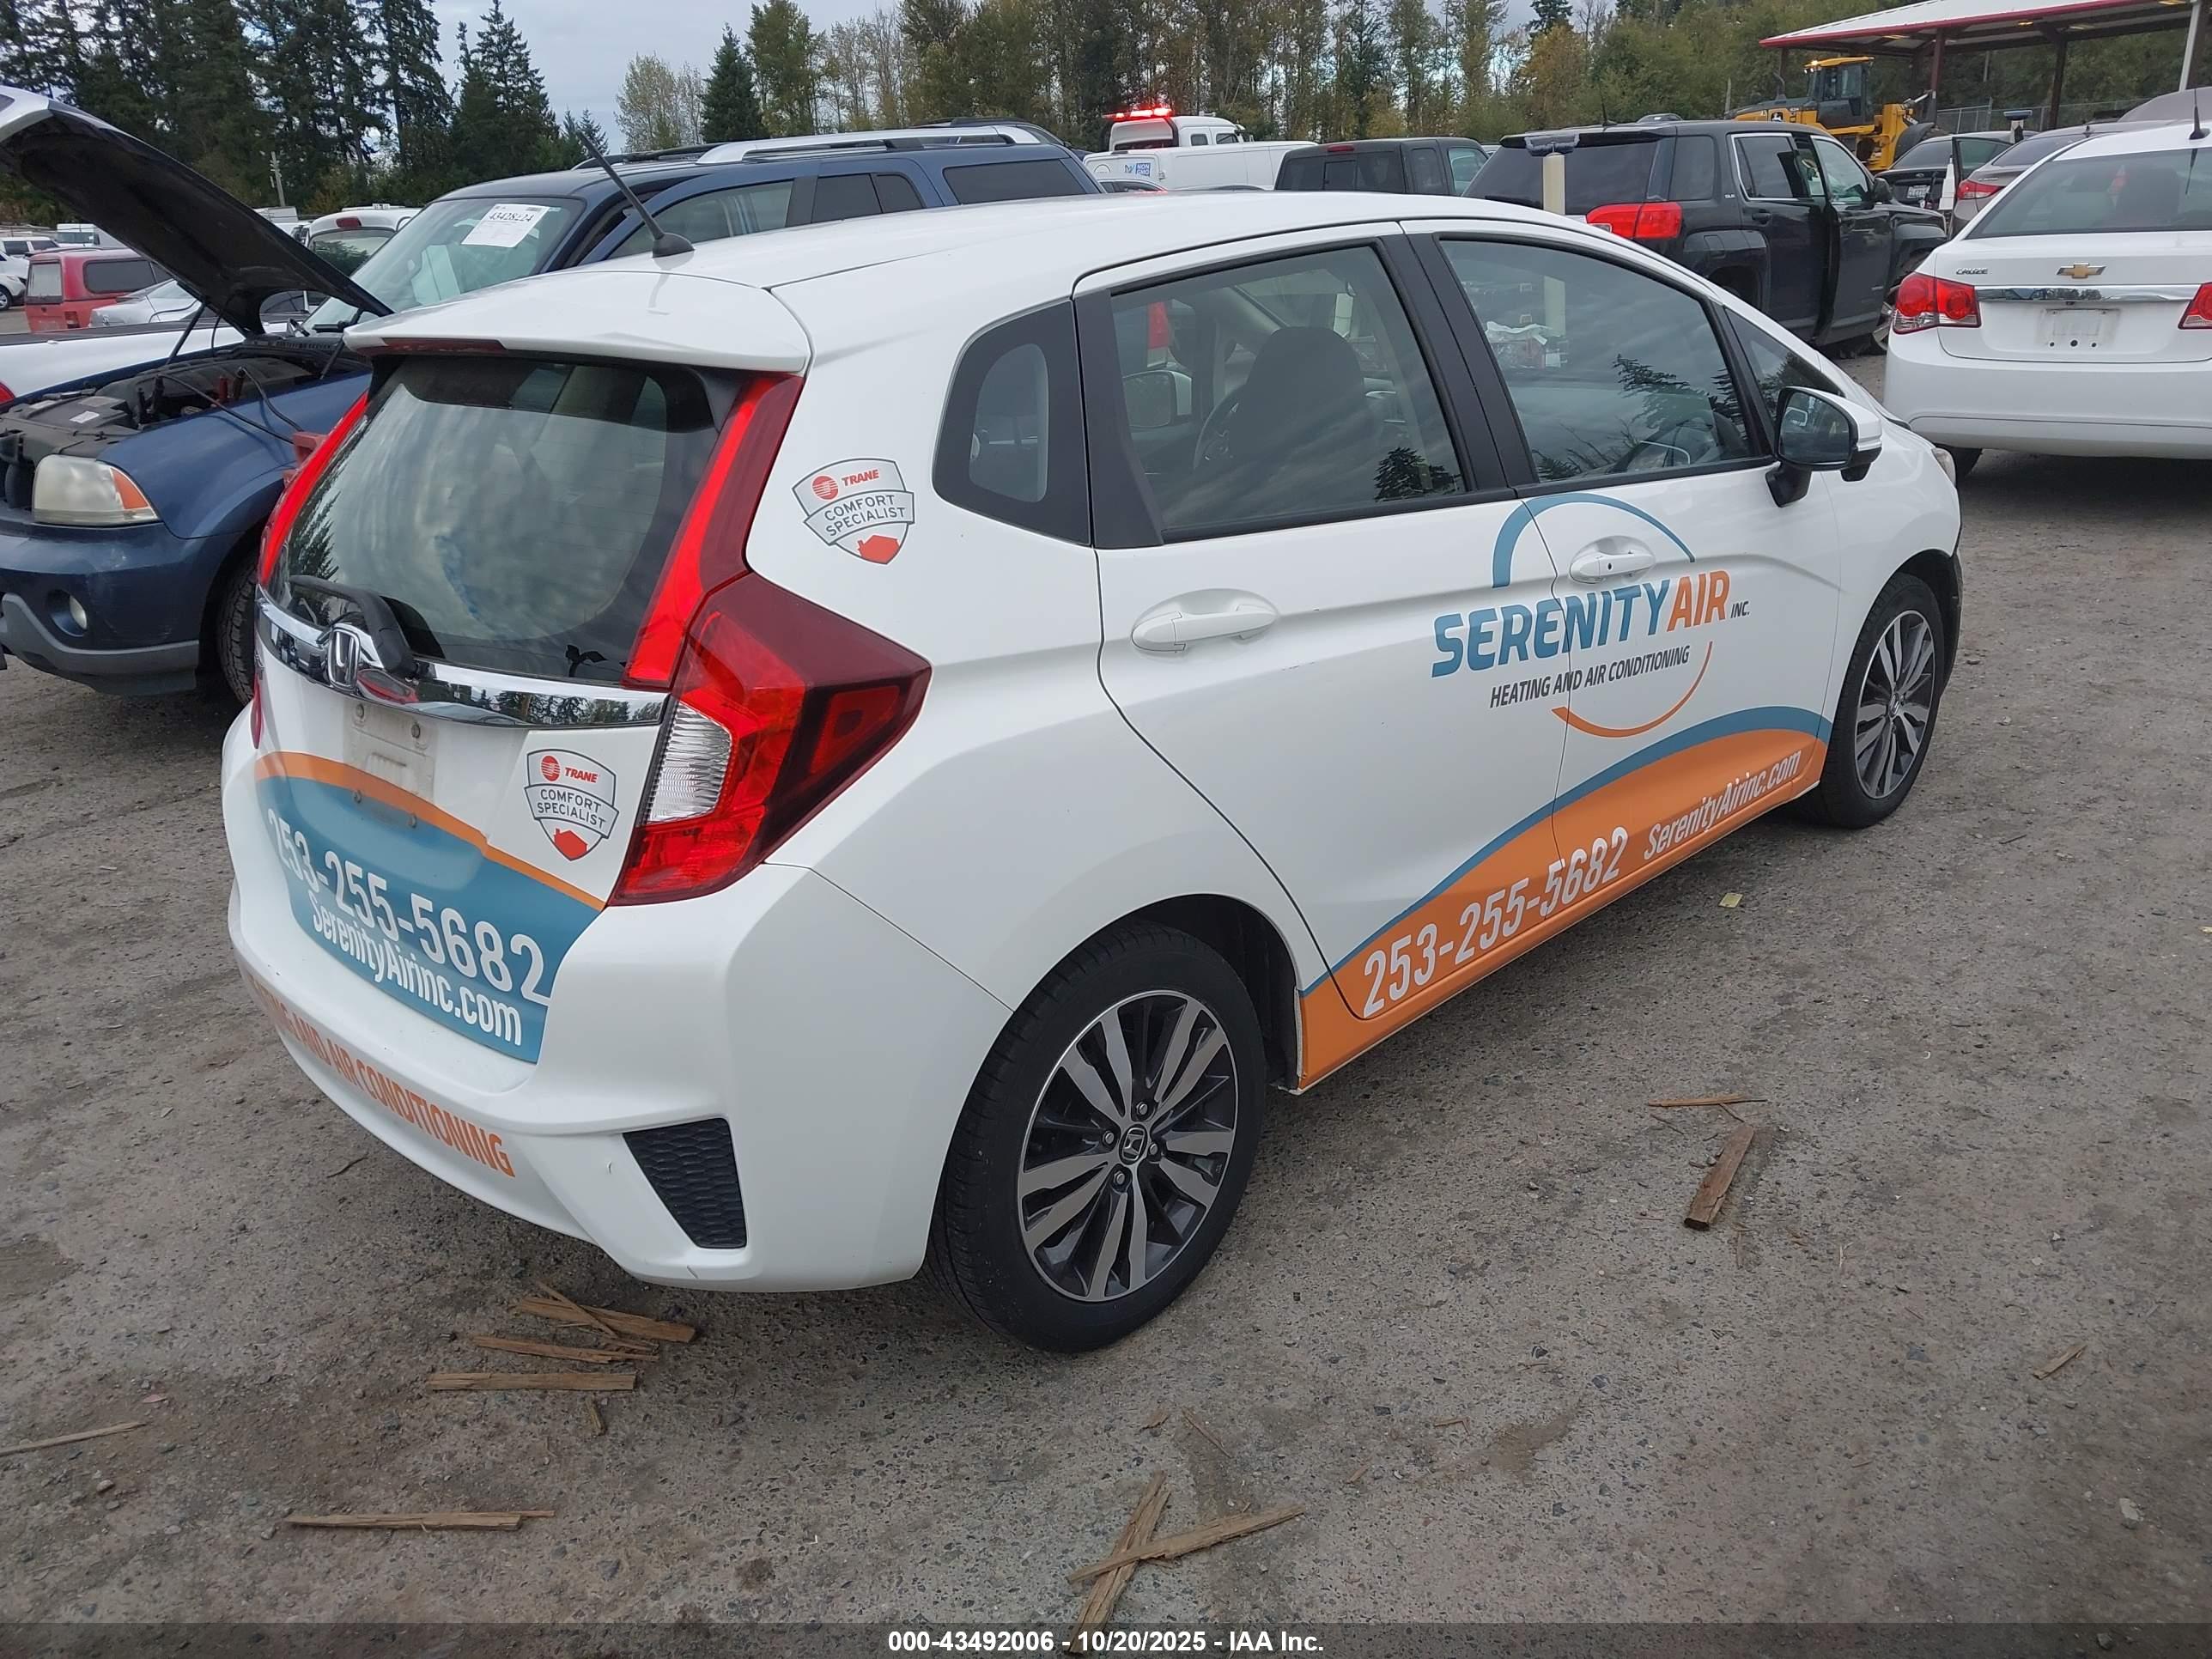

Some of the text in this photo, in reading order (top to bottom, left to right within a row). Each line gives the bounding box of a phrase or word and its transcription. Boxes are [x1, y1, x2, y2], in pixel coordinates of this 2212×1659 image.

[842, 469, 880, 487] TRANE
[824, 495, 895, 521] COMFORT
[826, 507, 906, 537] SPECIALIST
[1731, 600, 1750, 619] INC.
[1490, 645, 1691, 708] HEATING AND AIR CONDITIONING
[565, 767, 598, 783] TRANE
[540, 789, 601, 813] COMFORT
[537, 802, 606, 829] SPECIALIST
[1364, 749, 1802, 1018] 253-255-5682 SerenityAirinc.com
[268, 808, 551, 1007] 253-255-5682
[307, 890, 522, 1047] SerenityAirinc.com
[356, 1058, 515, 1177] CONDITIONING
